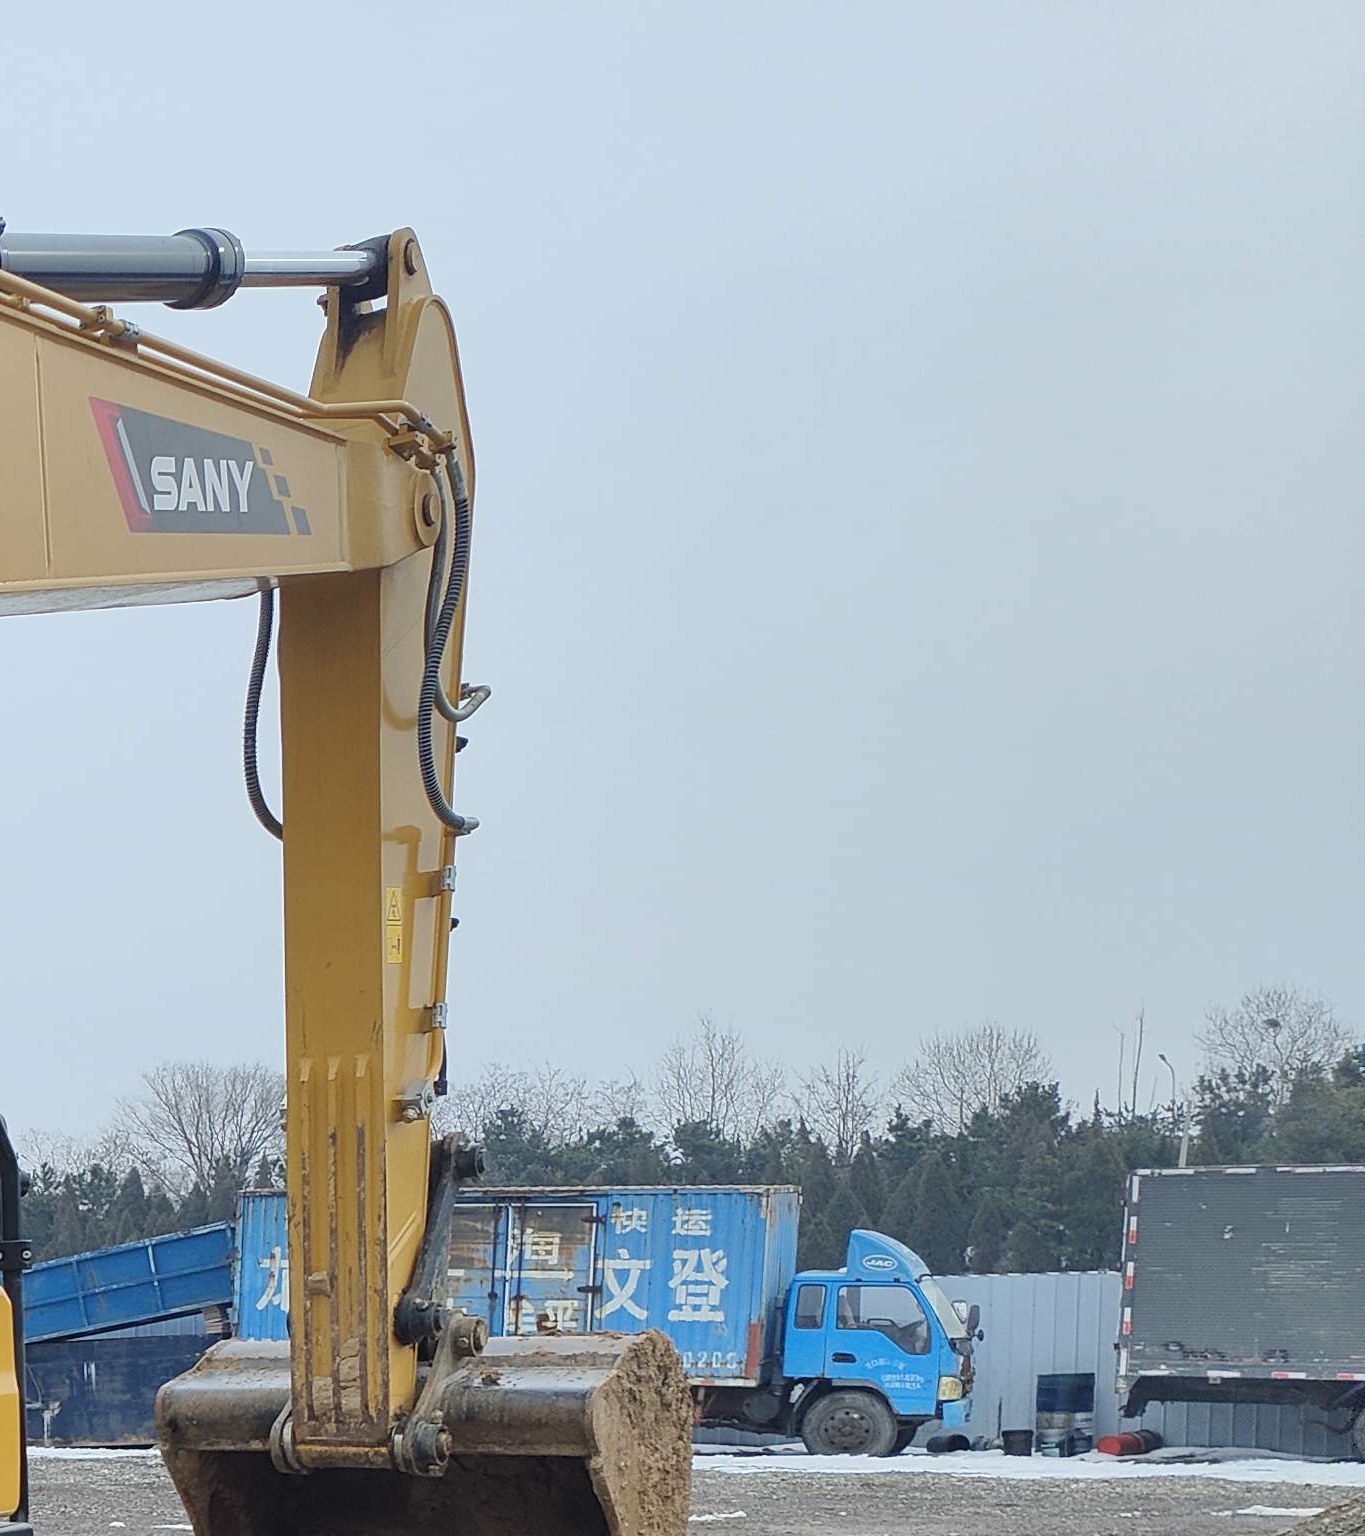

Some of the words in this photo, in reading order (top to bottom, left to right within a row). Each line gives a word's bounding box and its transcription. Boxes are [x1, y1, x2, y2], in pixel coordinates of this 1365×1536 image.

[150, 455, 254, 513] SANY
[611, 1206, 713, 1236] 快运
[594, 1248, 730, 1322] 文登
[866, 1259, 894, 1268] JAC
